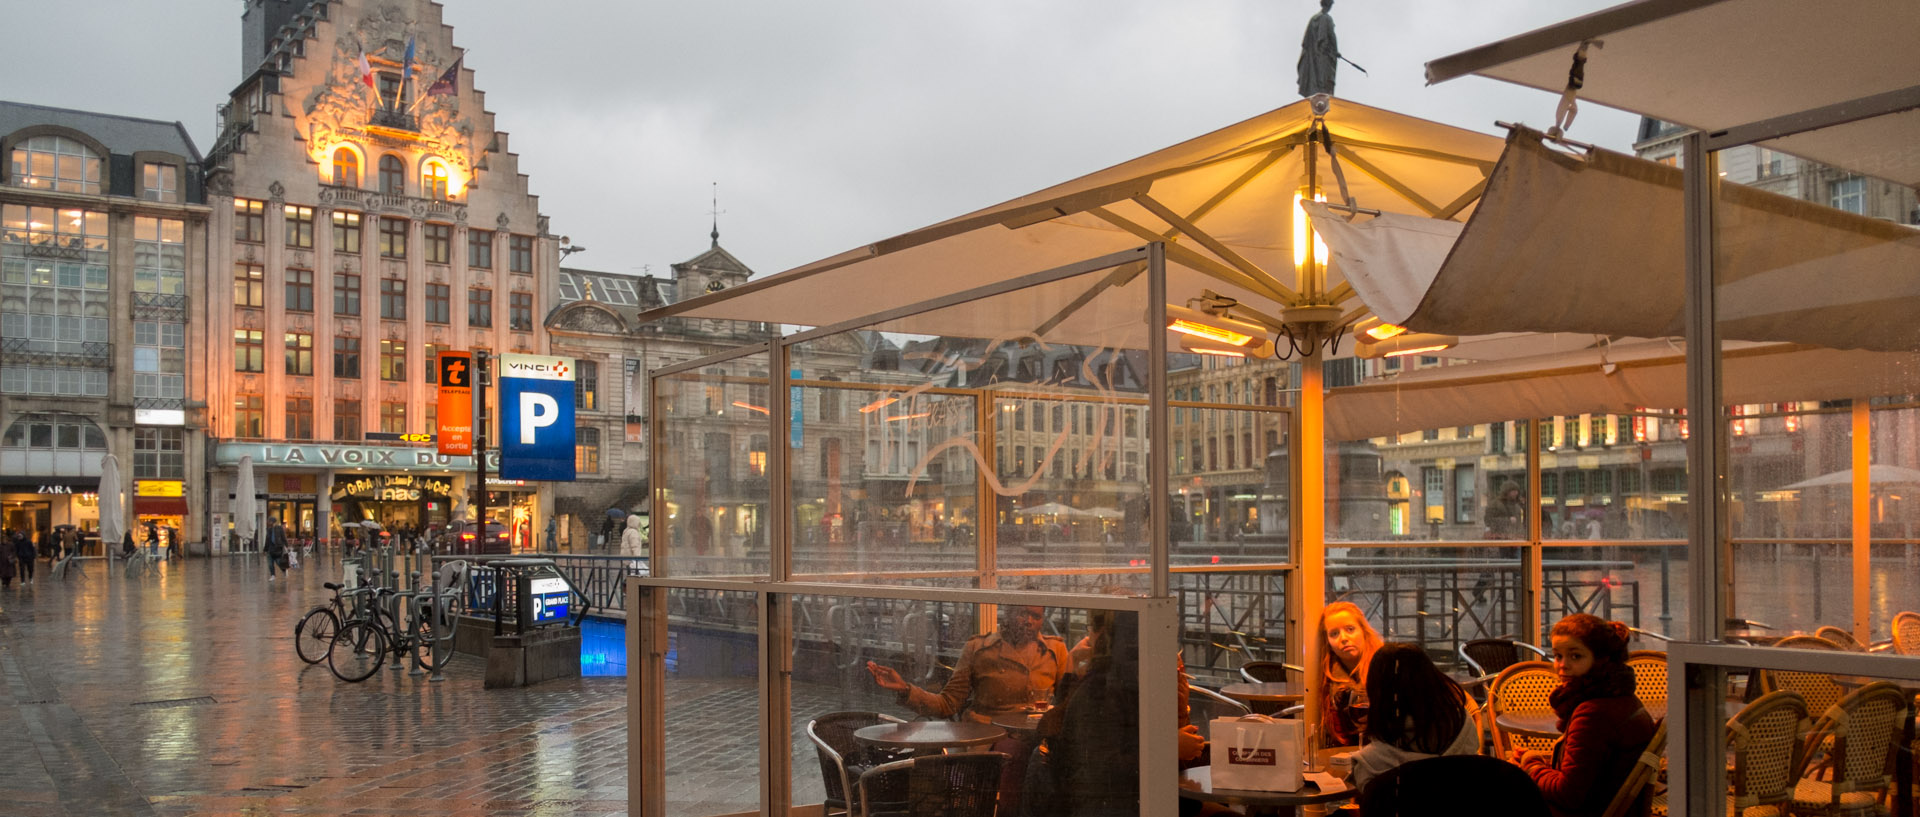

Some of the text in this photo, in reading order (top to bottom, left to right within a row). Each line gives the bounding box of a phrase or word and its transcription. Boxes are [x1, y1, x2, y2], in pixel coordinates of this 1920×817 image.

[509, 363, 549, 372] VINCI
[519, 391, 559, 445] P
[445, 442, 469, 450] sortie
[263, 447, 306, 464] LA
[320, 448, 397, 465] VOIX
[415, 450, 453, 466] DU
[37, 484, 73, 495] ZARA
[374, 486, 421, 501] fnac
[533, 597, 542, 621] P
[558, 596, 569, 604] PLACE
